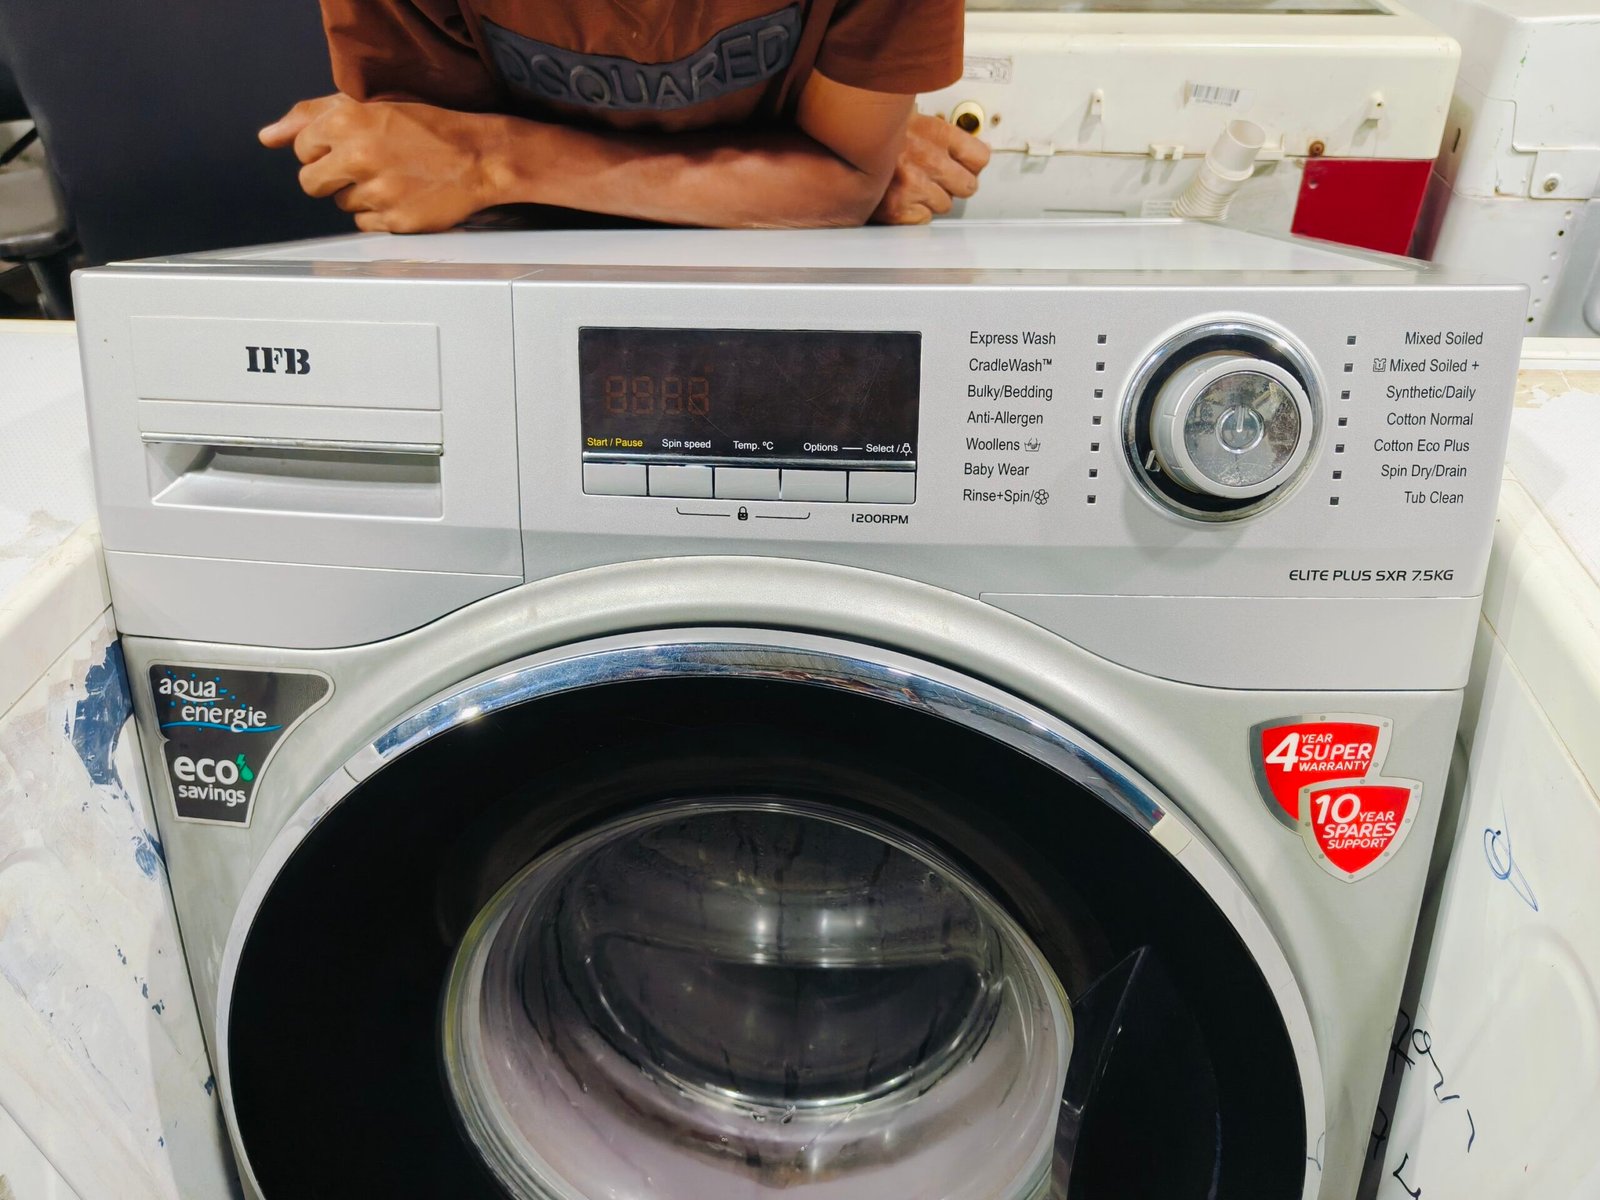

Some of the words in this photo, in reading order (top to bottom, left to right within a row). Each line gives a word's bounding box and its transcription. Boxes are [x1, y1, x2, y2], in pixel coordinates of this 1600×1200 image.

[969, 331, 1018, 347] Express
[1022, 331, 1056, 344] Wash
[1404, 331, 1442, 345] Mixed
[1445, 331, 1484, 345] Soiled
[245, 346, 311, 375] IFB
[1389, 359, 1426, 372] Mixed
[1429, 358, 1468, 372] Soiled
[967, 384, 1053, 402] Bulky/Bedding
[1386, 385, 1476, 402] Synthetic/Daily
[966, 410, 1044, 427] Anti-Allergen
[1386, 412, 1426, 426] Cotton
[1430, 412, 1474, 426] Normal
[586, 437, 609, 447] Start
[615, 437, 643, 448] Pause
[661, 438, 682, 449] Spin
[684, 440, 712, 450] speed
[733, 440, 760, 451] Temp.
[803, 442, 839, 452] Options
[865, 443, 895, 453] Select
[965, 437, 1020, 451] Woollens
[1373, 438, 1413, 452] Cotton
[1417, 438, 1440, 452] Eco
[1443, 439, 1470, 452] Plus
[964, 462, 994, 478] Baby
[997, 463, 1030, 476] Wear
[1380, 464, 1408, 480] Spin
[1411, 464, 1467, 480] Dry/Drain
[1404, 491, 1426, 504] Tub
[1429, 491, 1465, 504] Clean
[850, 513, 909, 525] 1200RPM
[1289, 569, 1329, 581] ELITE
[1332, 570, 1372, 581] PLUS
[1375, 570, 1407, 581] SXR
[1411, 570, 1454, 581] 7.5KG
[158, 677, 224, 703] aqua
[181, 704, 267, 733] energie
[1301, 733, 1333, 743] YEAR
[1265, 732, 1300, 772] 4
[1299, 743, 1373, 761] SUPER
[173, 756, 239, 785] eco
[1299, 760, 1370, 772] WARRANTY
[178, 783, 246, 807] savings
[1315, 793, 1361, 825] 10
[1359, 811, 1395, 822] YEAR
[1322, 822, 1396, 838] SPARES
[1327, 838, 1387, 849] SUPPORT
